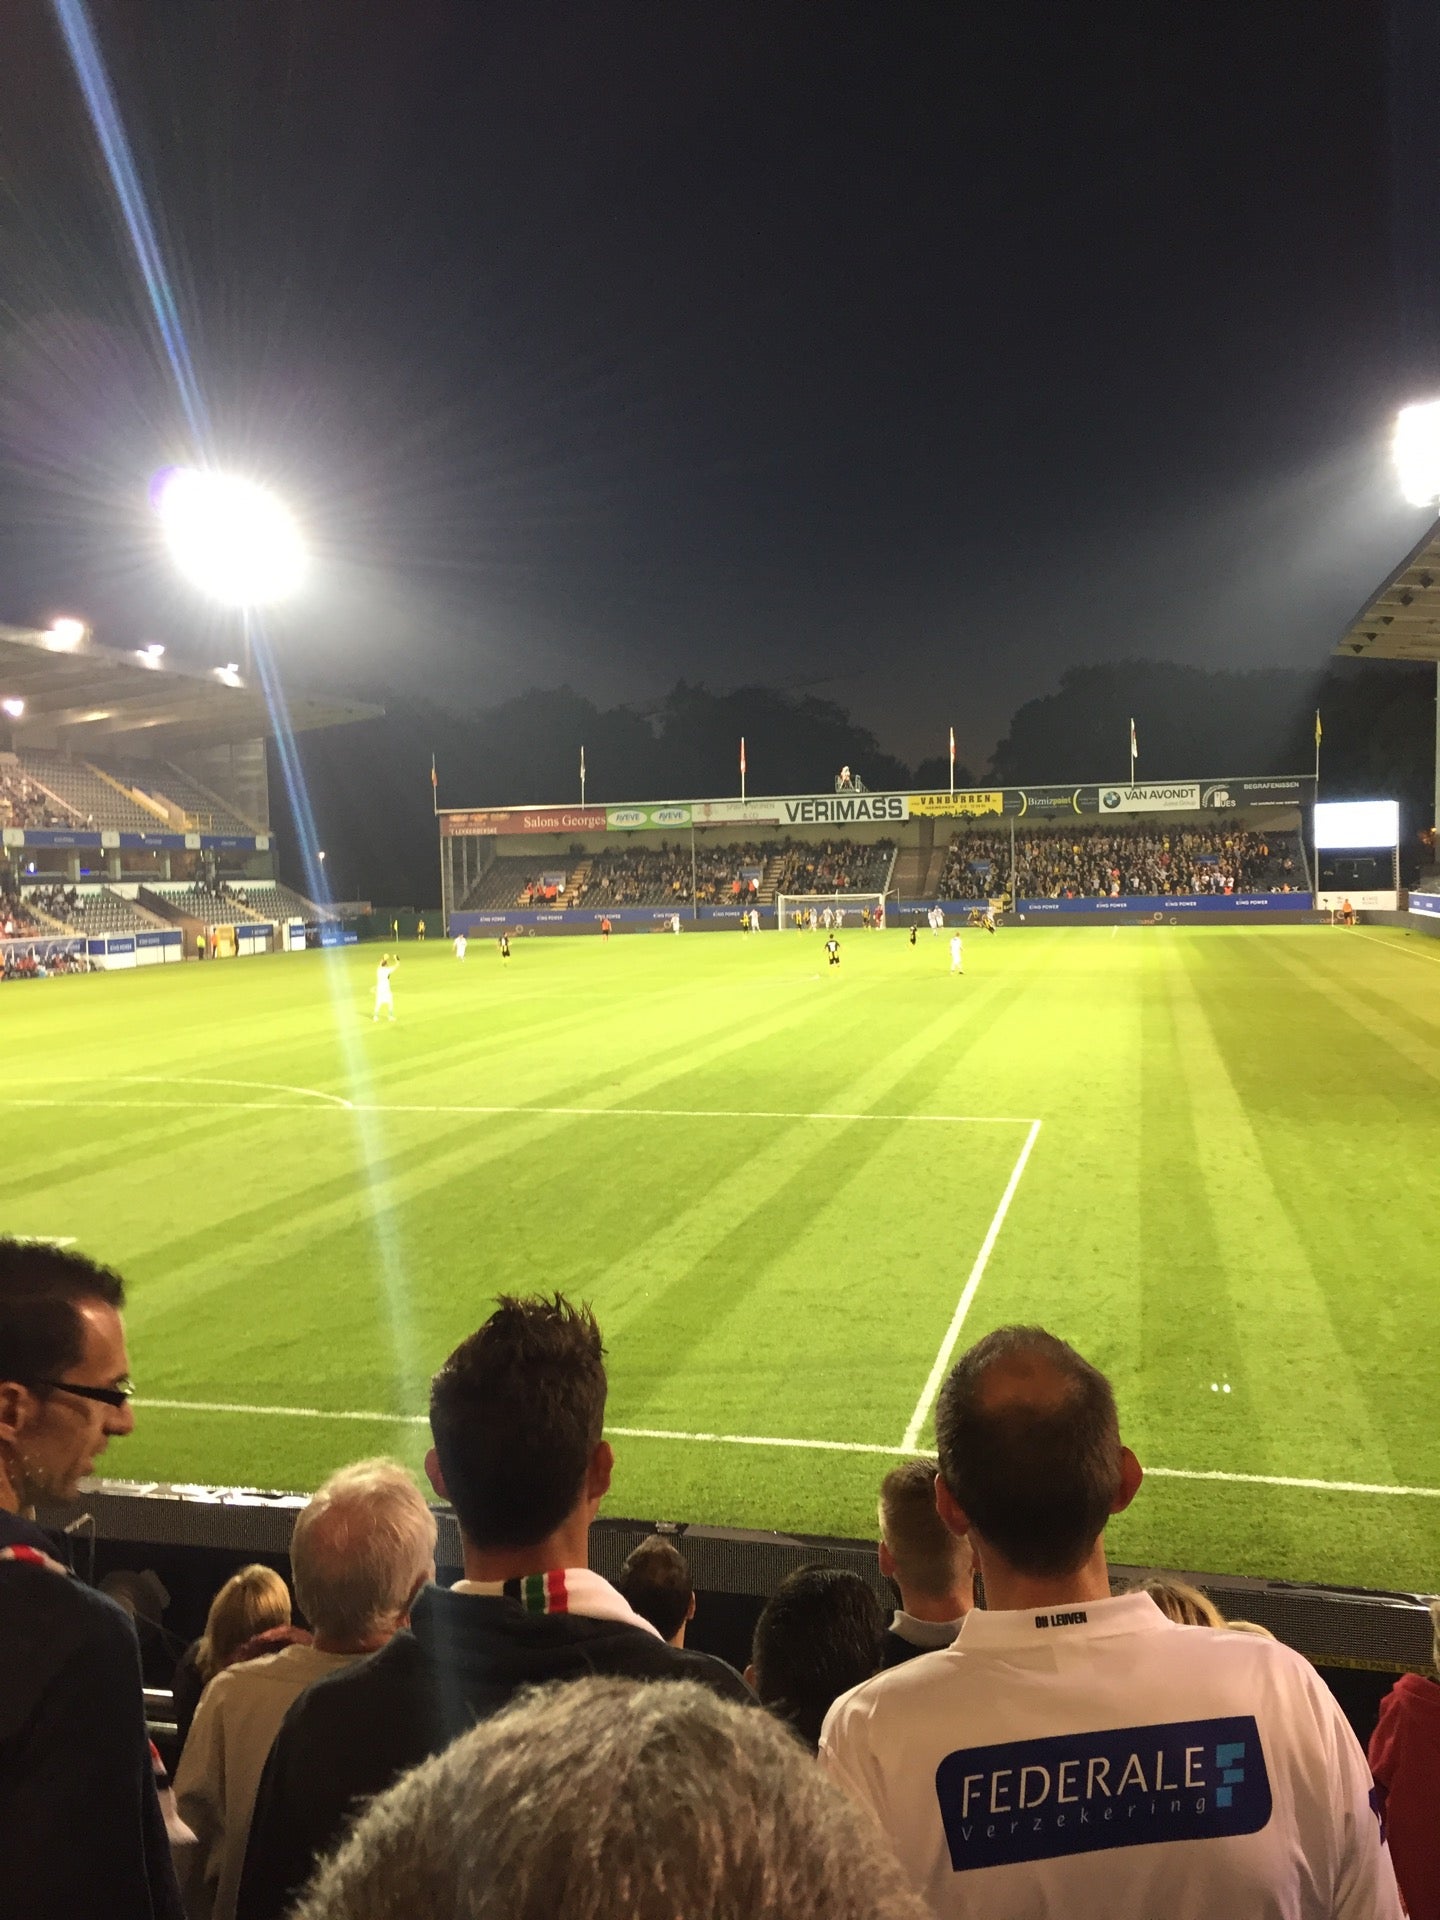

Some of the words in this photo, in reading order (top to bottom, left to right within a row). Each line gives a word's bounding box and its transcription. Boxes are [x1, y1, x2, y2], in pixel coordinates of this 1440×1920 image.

[1124, 791, 1147, 801] VAN
[1149, 788, 1196, 800] AVONDT
[615, 810, 641, 822] AVEVE
[658, 808, 684, 820] AVEVE
[785, 797, 903, 822] VERIMASS
[523, 815, 560, 828] Salons
[561, 814, 607, 829] Georges
[1051, 1611, 1088, 1627] LEUVEN
[962, 1746, 1206, 1819] FEDERALE
[961, 1797, 1206, 1841] Verzekering
